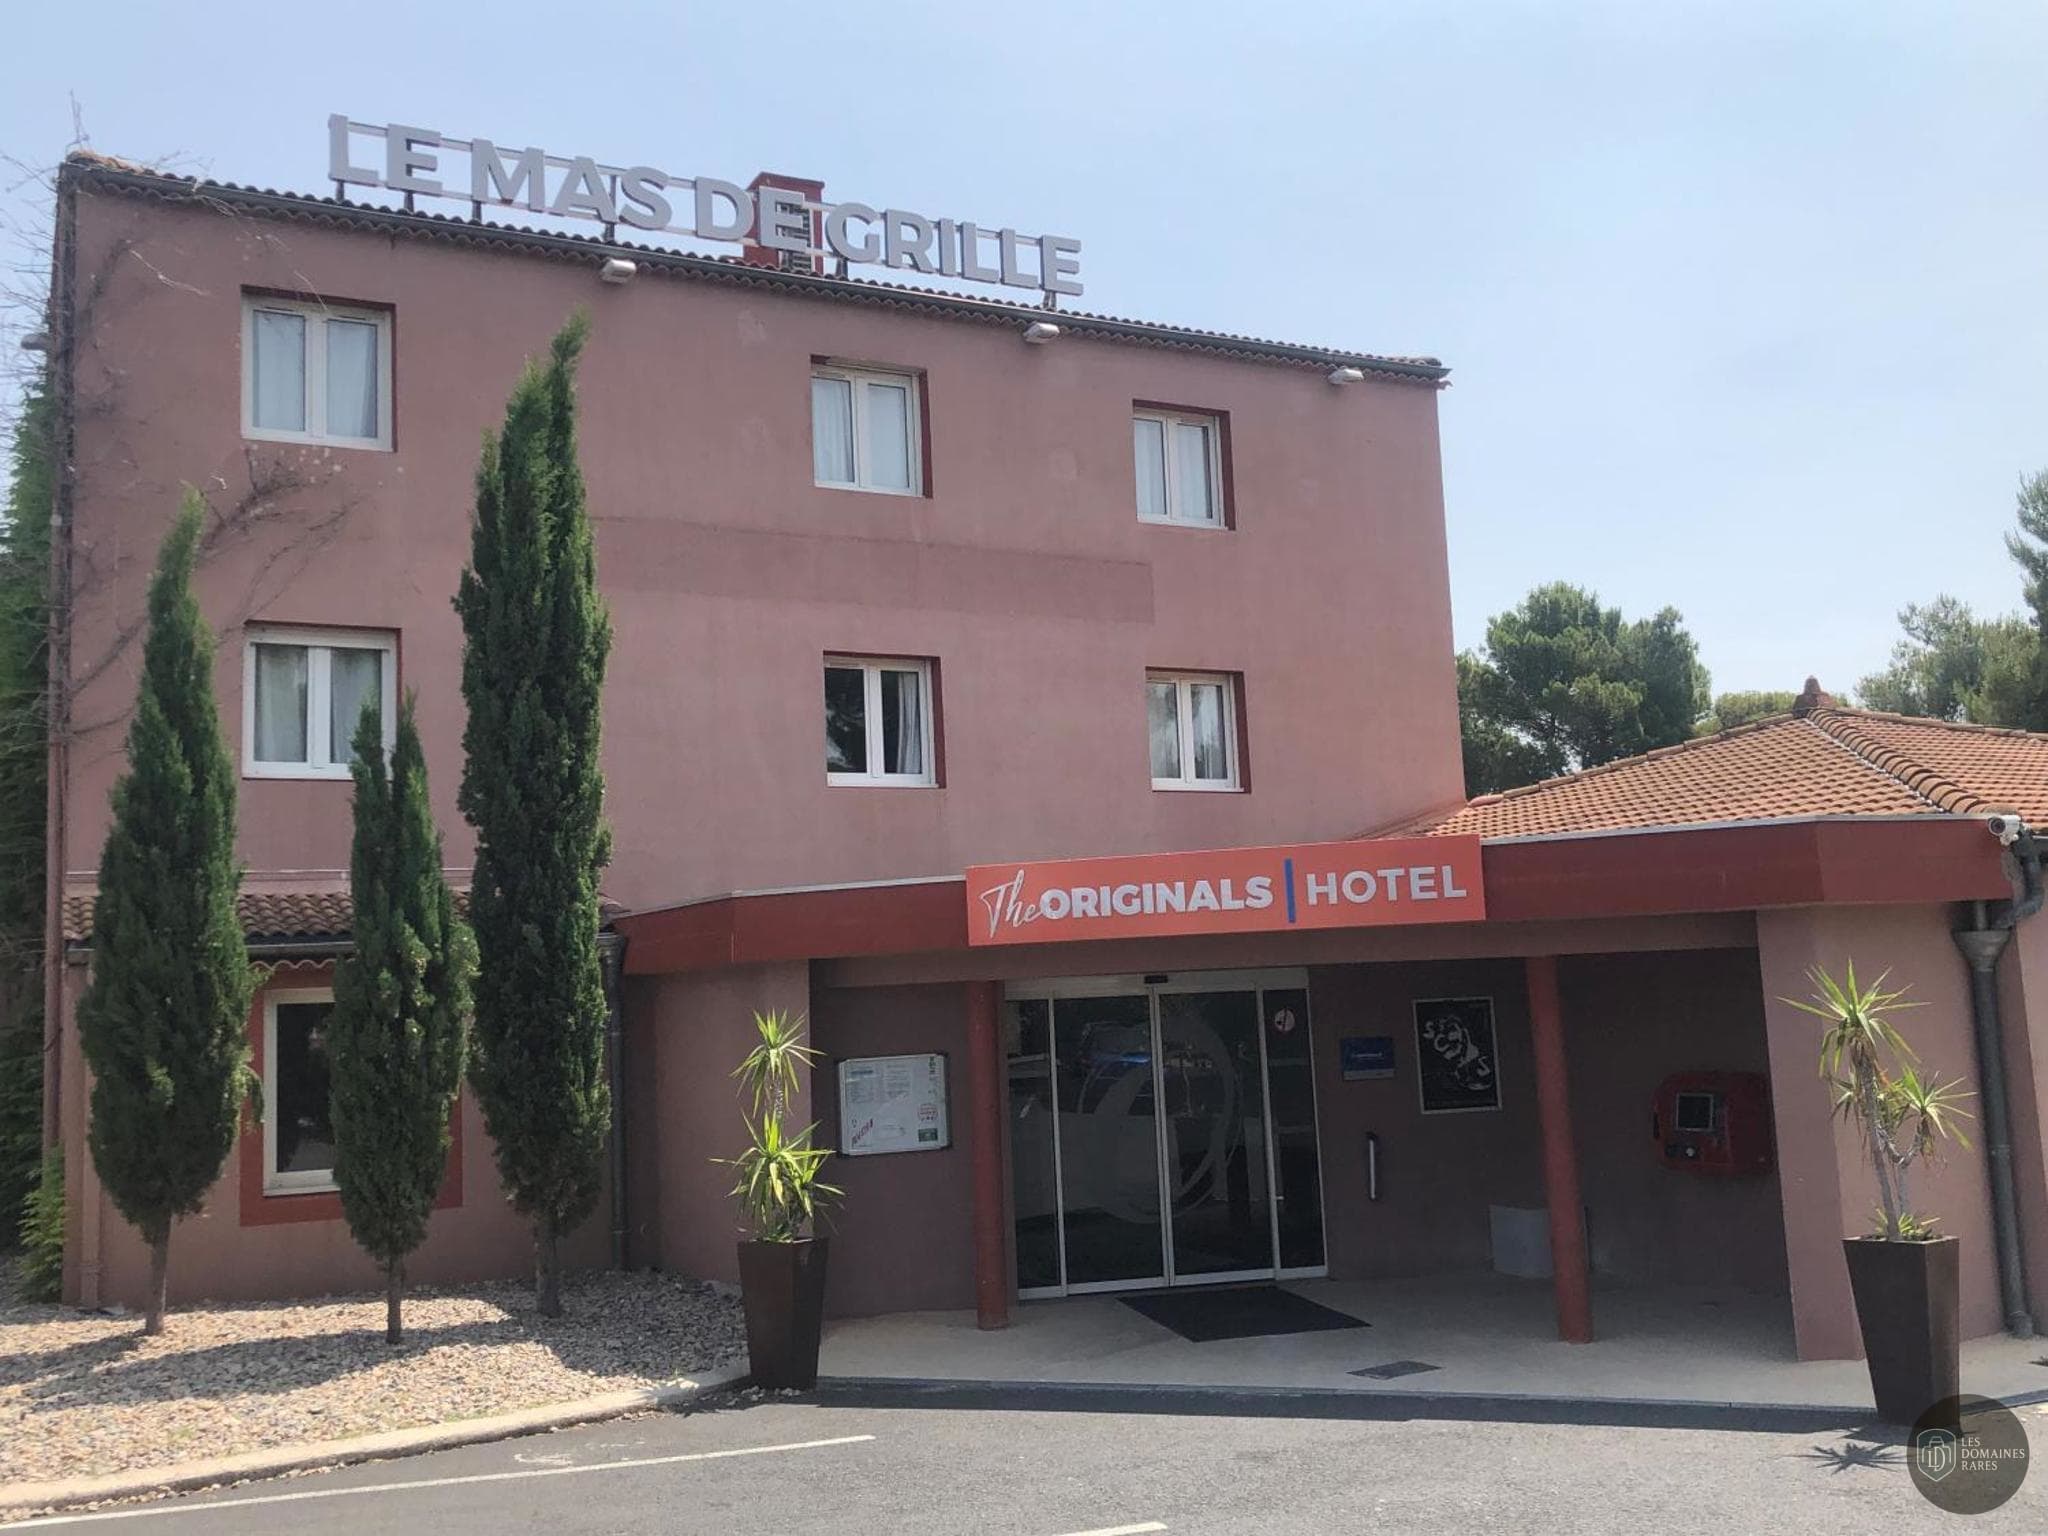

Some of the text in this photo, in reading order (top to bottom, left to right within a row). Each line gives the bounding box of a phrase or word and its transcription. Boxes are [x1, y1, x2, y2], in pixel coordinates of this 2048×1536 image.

[328, 113, 1084, 296] LE MAS DE GRILLE
[979, 865, 1467, 938] The ORIGINALS HOTEL
